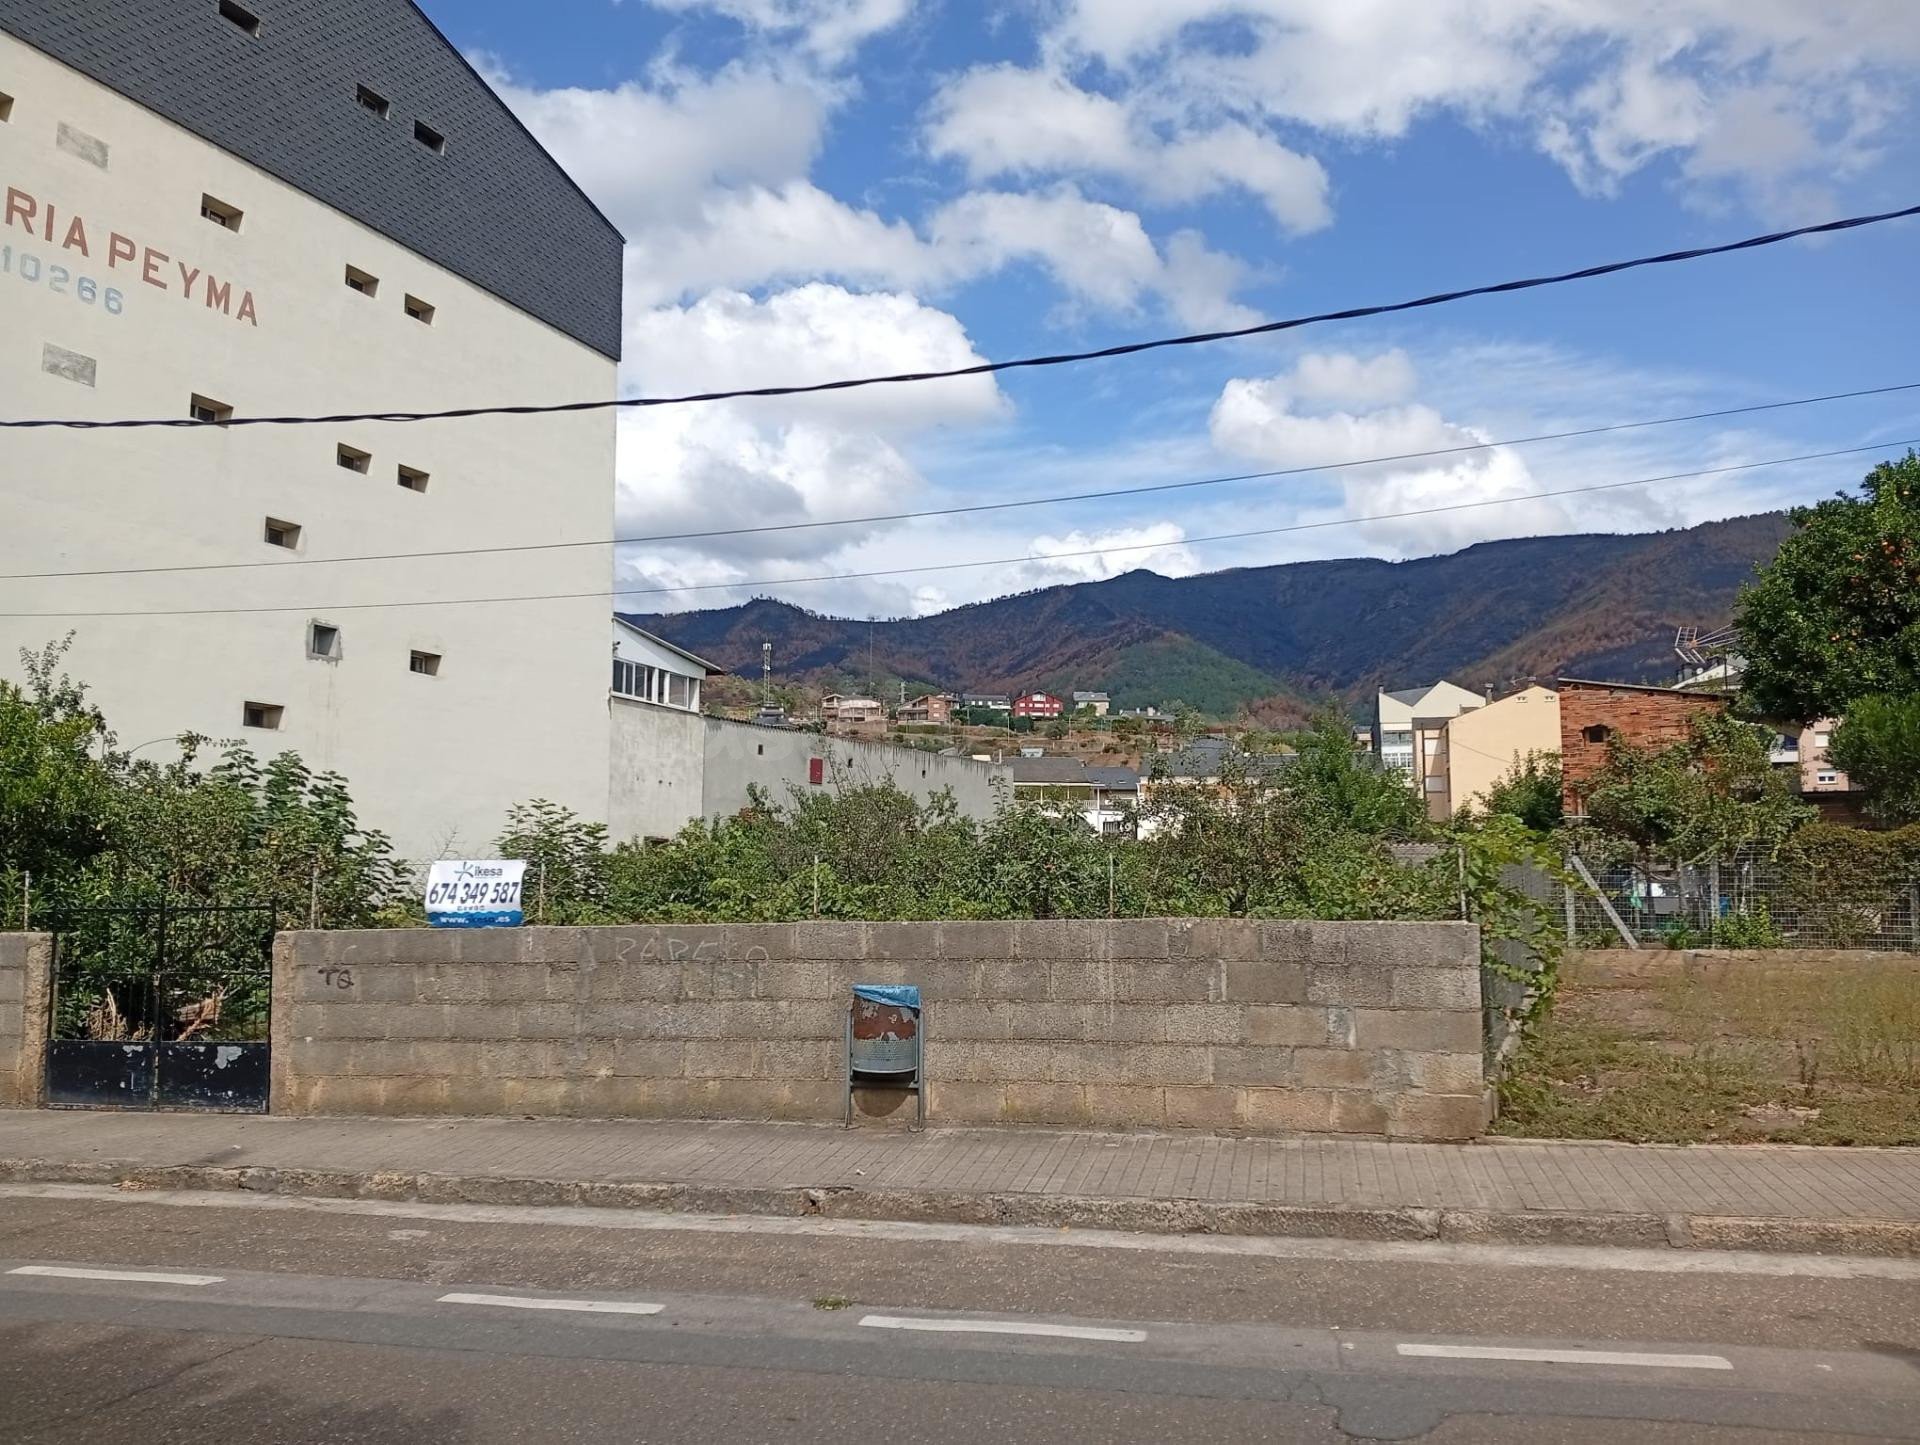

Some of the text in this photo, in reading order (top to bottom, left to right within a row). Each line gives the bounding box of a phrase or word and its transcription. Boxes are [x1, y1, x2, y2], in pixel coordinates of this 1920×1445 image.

[5, 186, 257, 327] RIA PEYMA
[429, 881, 520, 905] 674 349 587
